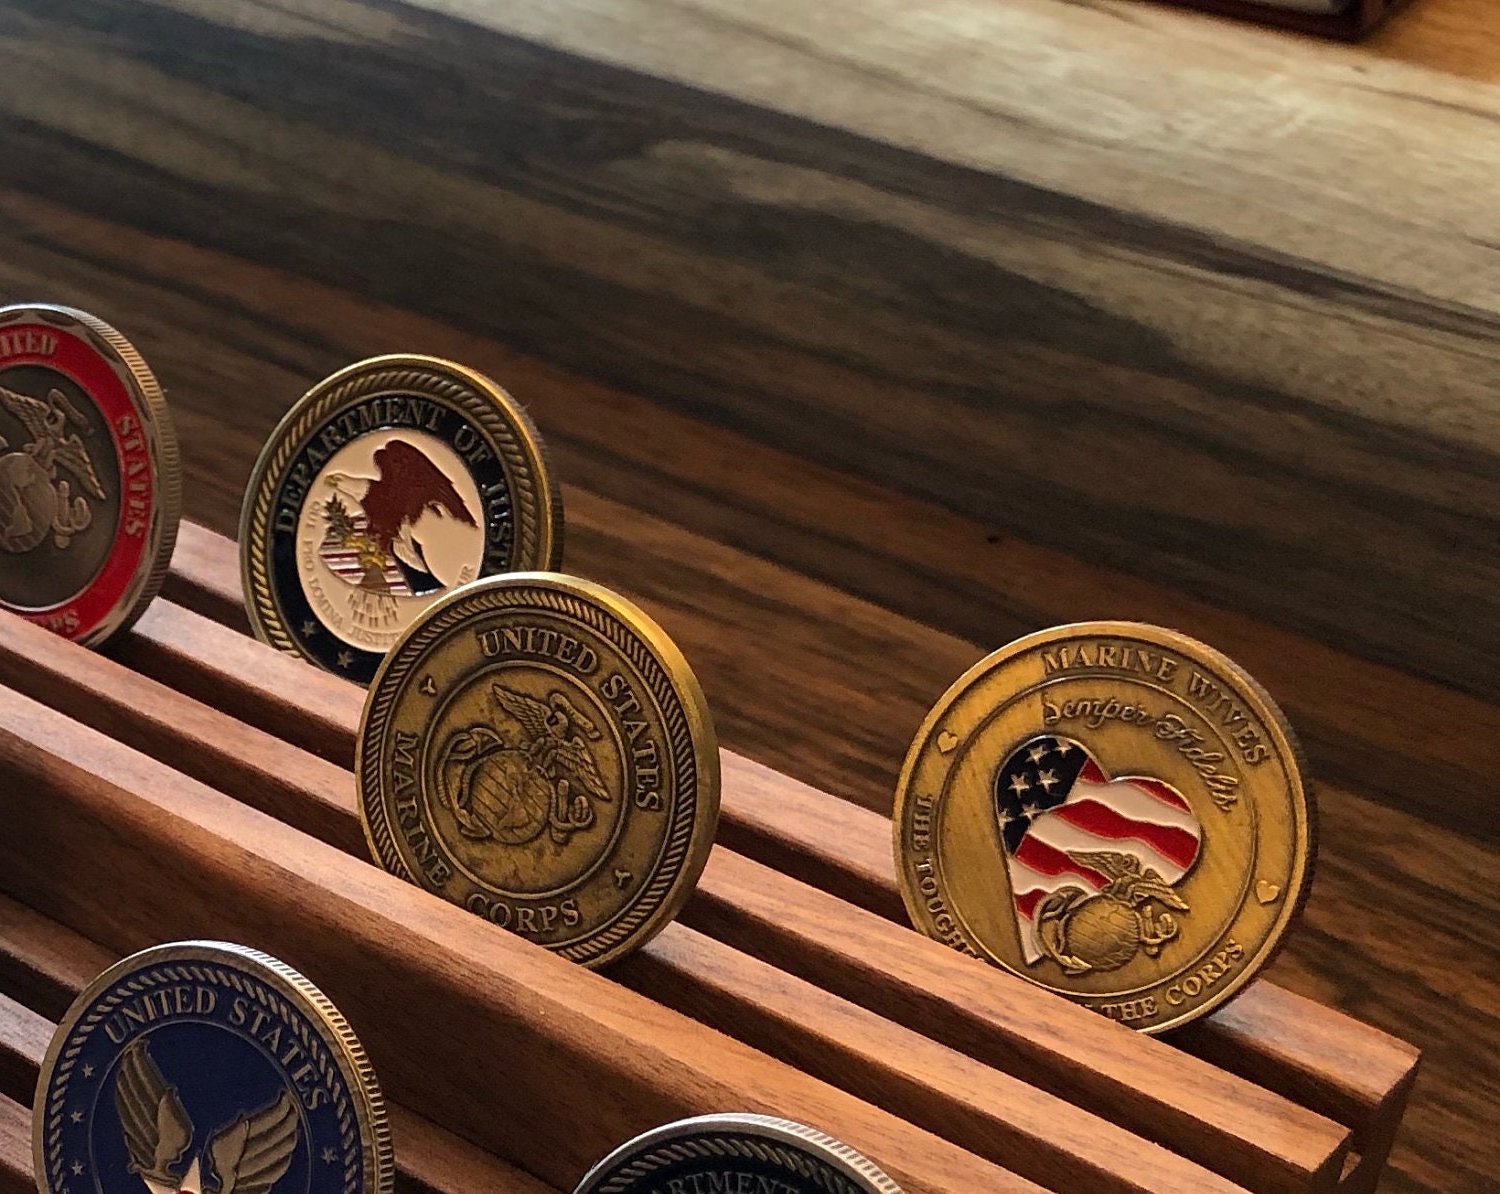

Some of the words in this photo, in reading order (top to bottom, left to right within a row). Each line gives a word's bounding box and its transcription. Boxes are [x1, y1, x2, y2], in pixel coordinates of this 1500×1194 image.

[113, 415, 151, 540] STATES
[276, 398, 446, 533] DEPARTMENT
[453, 424, 493, 464] OF
[479, 479, 512, 574] JUSTI
[350, 625, 399, 646] JUSTIT
[477, 626, 598, 674] UNITED
[602, 675, 661, 812] STATES
[1041, 645, 1181, 683] MARINE
[1187, 668, 1271, 766] WIVES
[1042, 693, 1152, 729] Semper
[393, 732, 454, 889] MARINE
[466, 893, 580, 933] CORPS
[911, 793, 933, 850] THE
[915, 853, 977, 956] TOUGH
[1101, 996, 1158, 1021] THE
[1165, 937, 1244, 1006] CORPS
[105, 986, 218, 1044] UNITED
[228, 999, 330, 1111] STATES
